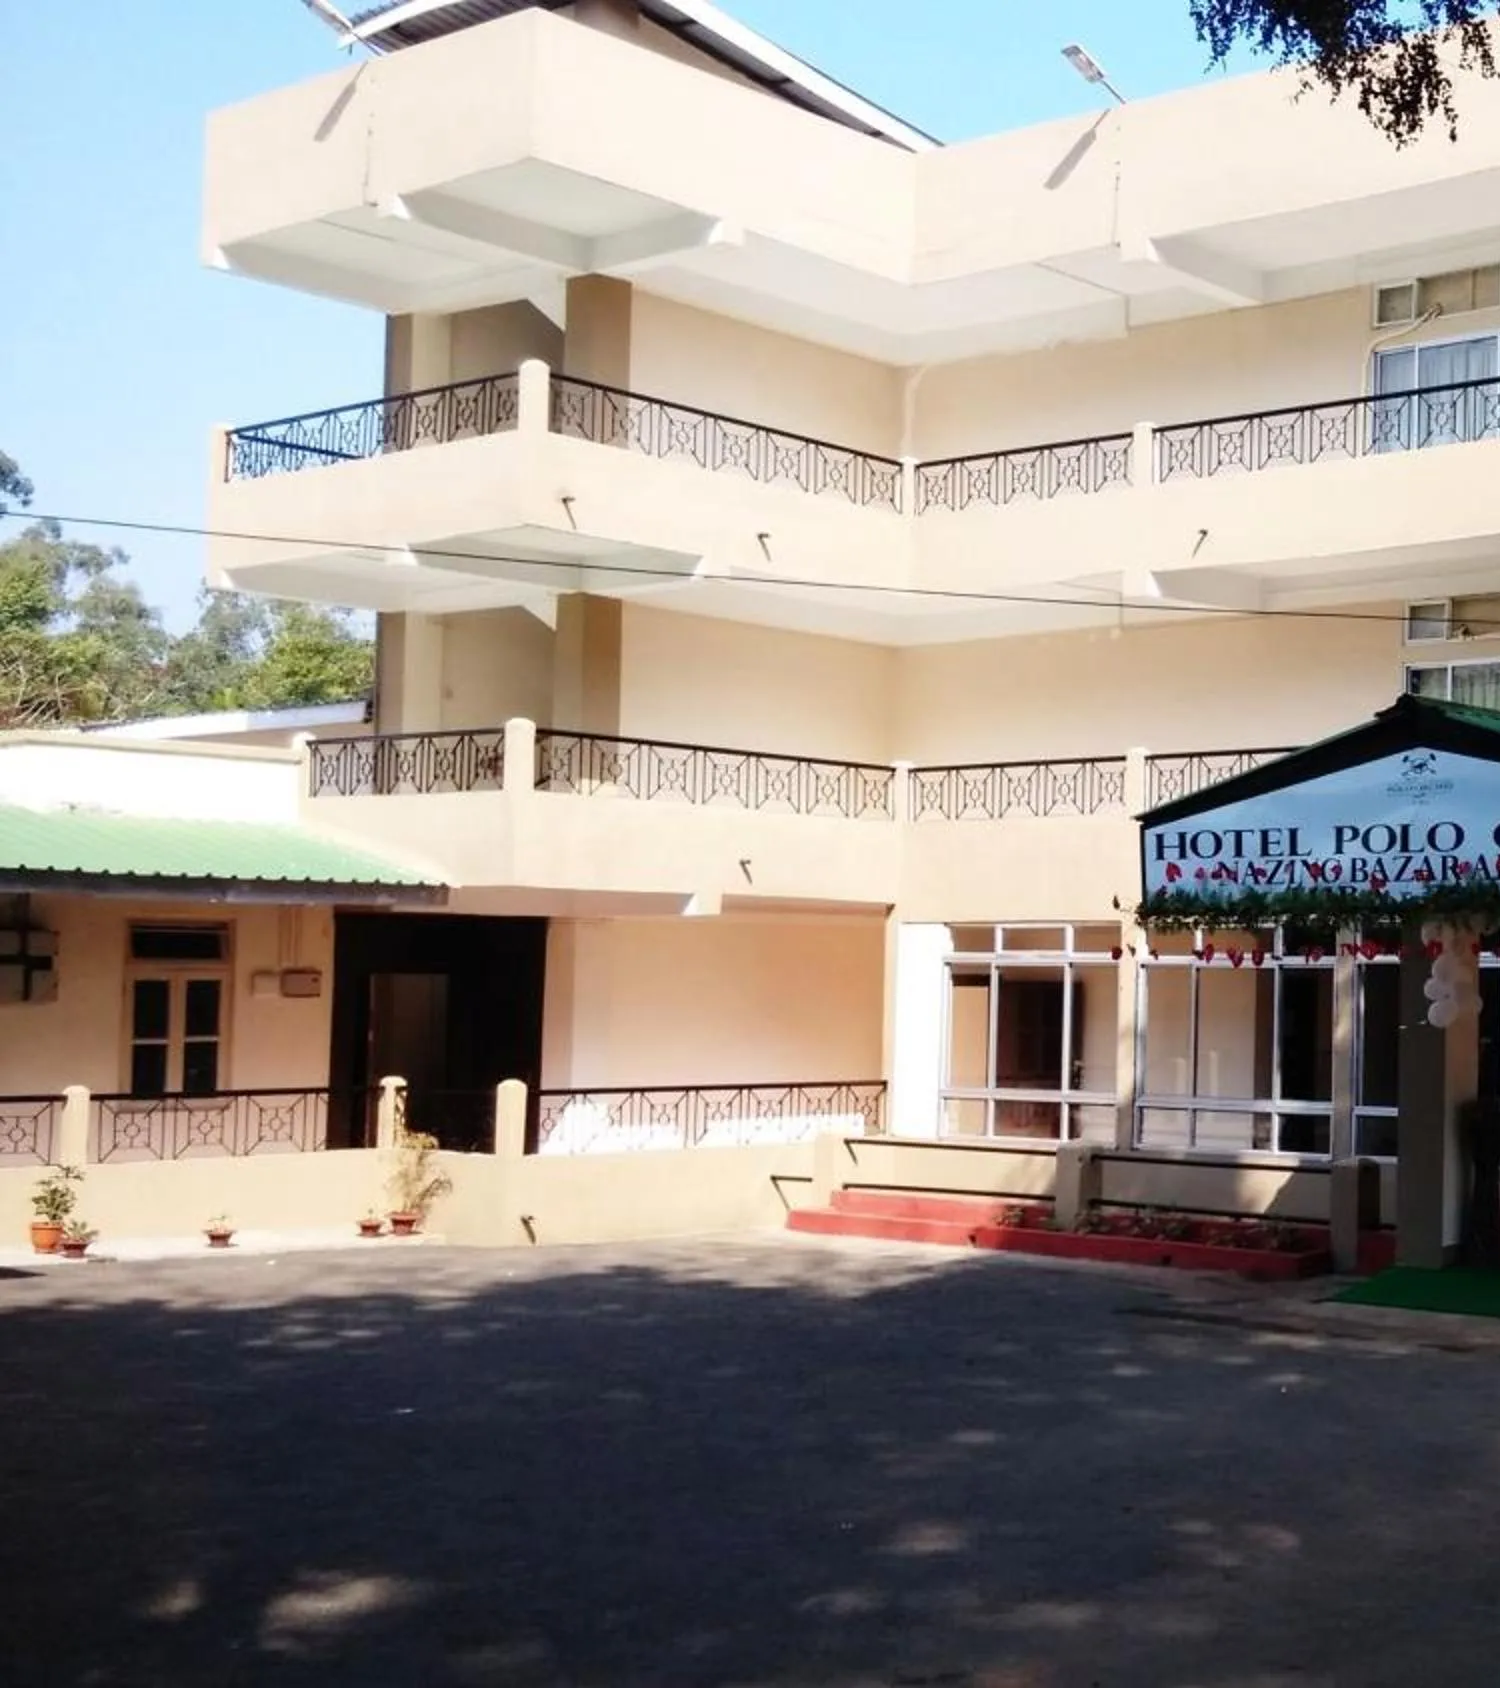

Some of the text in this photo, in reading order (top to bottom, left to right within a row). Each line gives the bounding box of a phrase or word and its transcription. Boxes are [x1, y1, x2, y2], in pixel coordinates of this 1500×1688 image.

[1154, 827, 1312, 860] HOTEL
[1334, 821, 1465, 854] POLO
[1350, 854, 1462, 883] BAZAR
